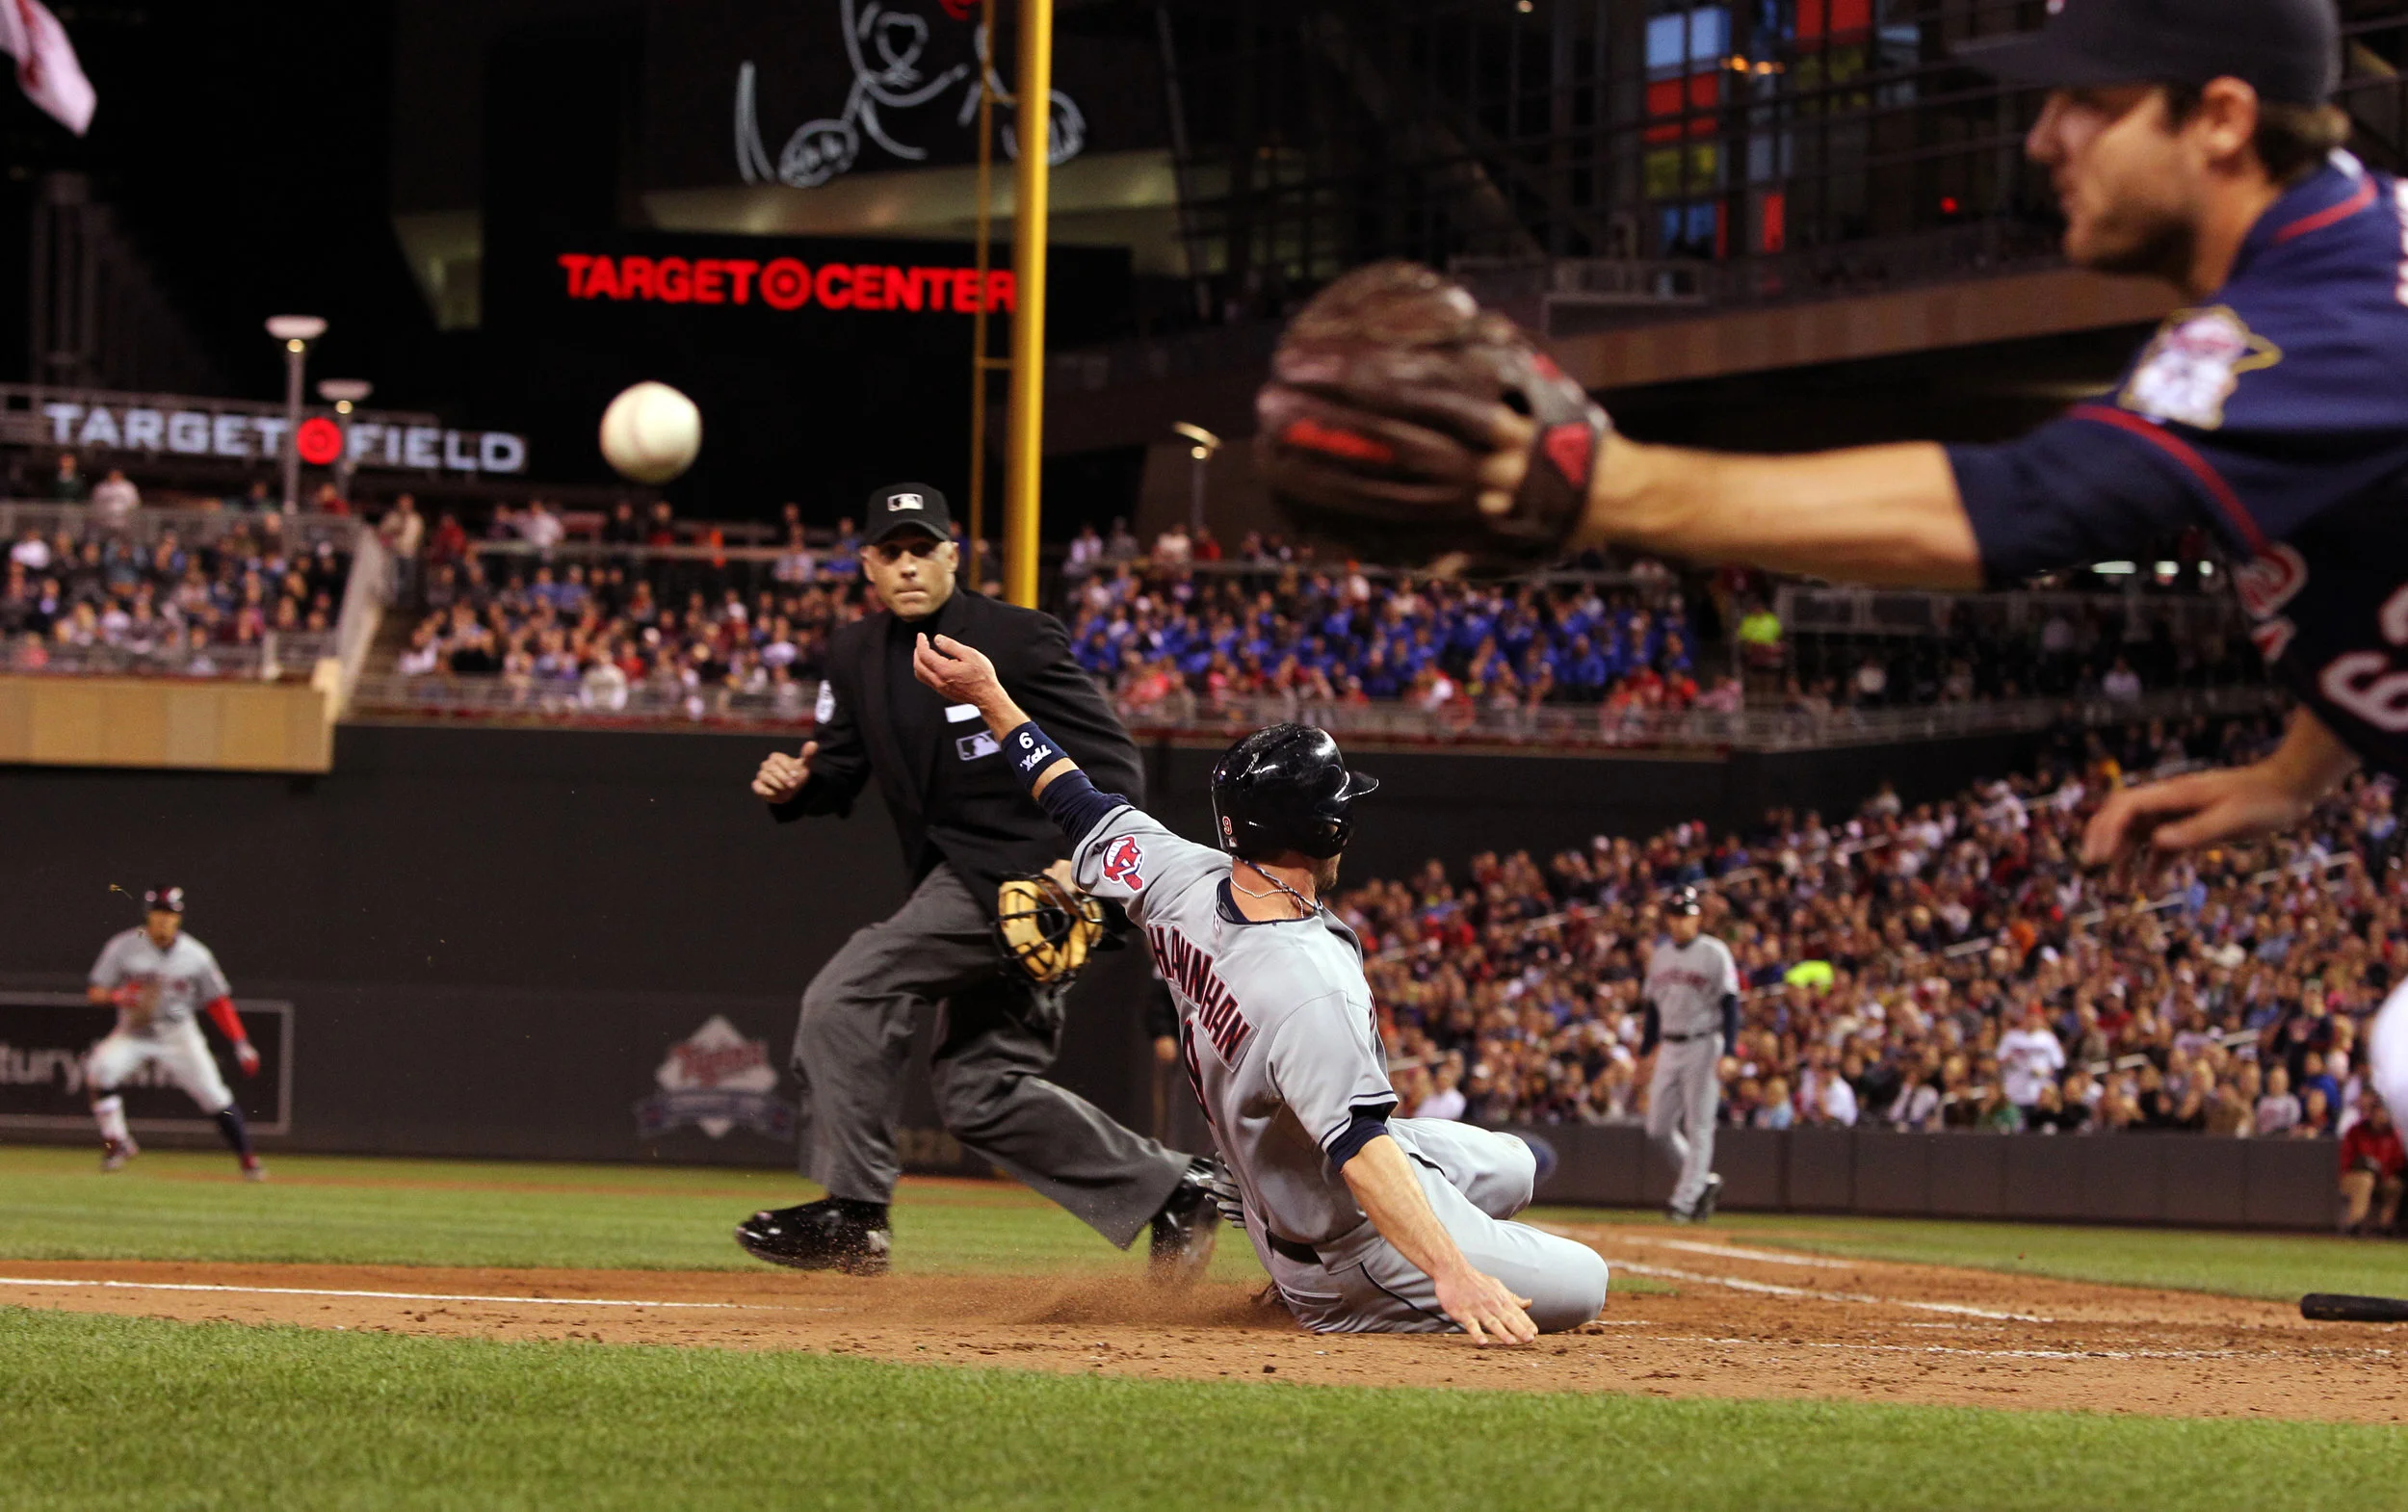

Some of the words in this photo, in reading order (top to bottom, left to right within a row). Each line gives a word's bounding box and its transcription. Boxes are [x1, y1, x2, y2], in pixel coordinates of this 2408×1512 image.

[559, 253, 758, 304] TARGET
[815, 264, 1016, 312] CENTER
[43, 404, 289, 456] TARGET
[347, 425, 527, 473] FIELD
[1221, 815, 1233, 836] 9
